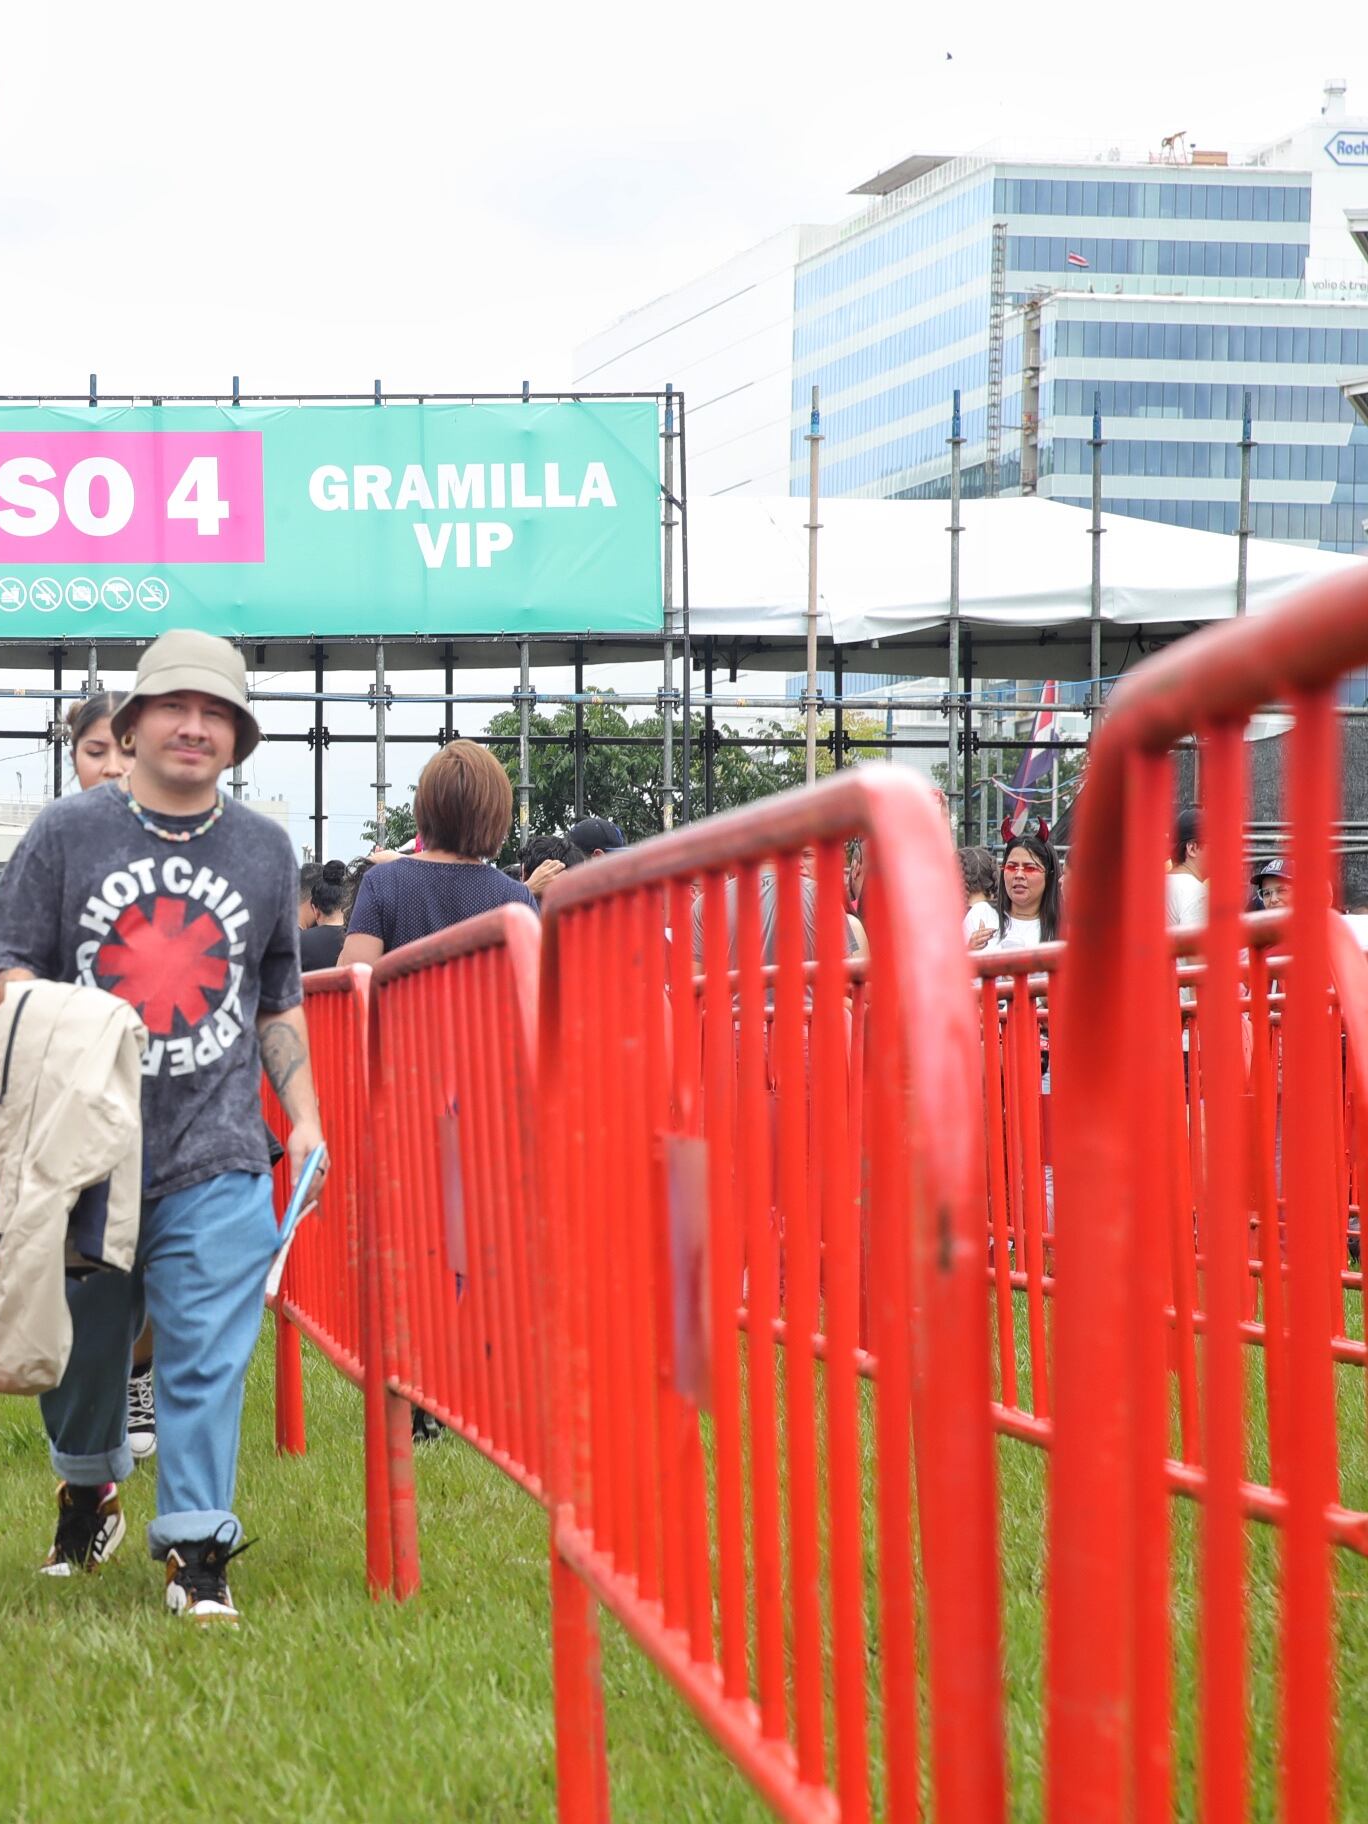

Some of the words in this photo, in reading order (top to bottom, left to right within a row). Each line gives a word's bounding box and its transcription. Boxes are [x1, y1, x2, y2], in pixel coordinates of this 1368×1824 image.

[166, 456, 230, 536] 4
[308, 461, 618, 511] GRAMILLA
[412, 521, 514, 569] VIP
[79, 857, 156, 936] HOT
[162, 856, 250, 955] CHILI
